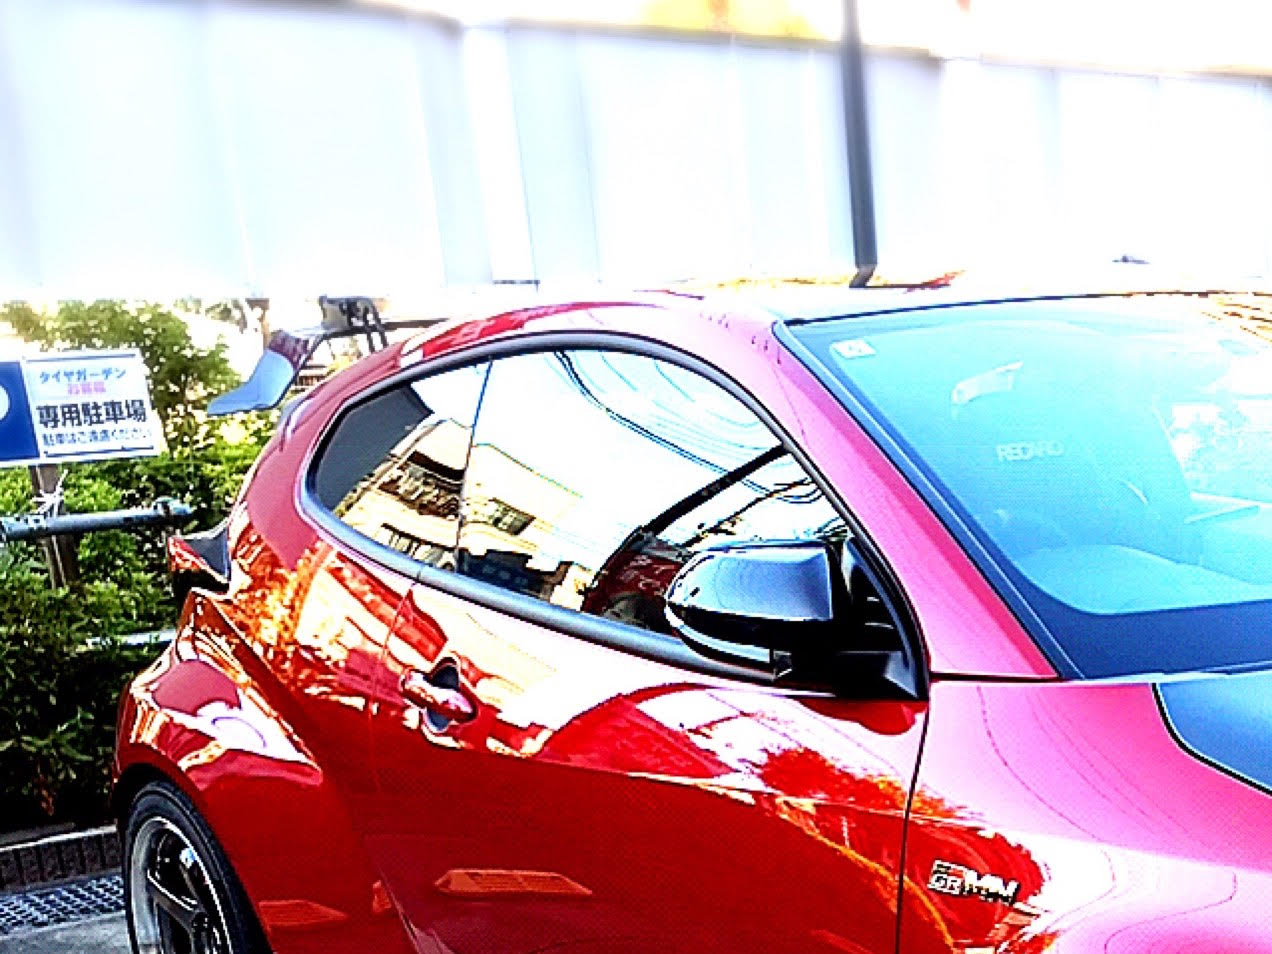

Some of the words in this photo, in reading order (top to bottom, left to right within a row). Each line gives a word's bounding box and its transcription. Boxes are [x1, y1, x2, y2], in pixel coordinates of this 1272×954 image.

[36, 399, 147, 428] 専用駐車場
